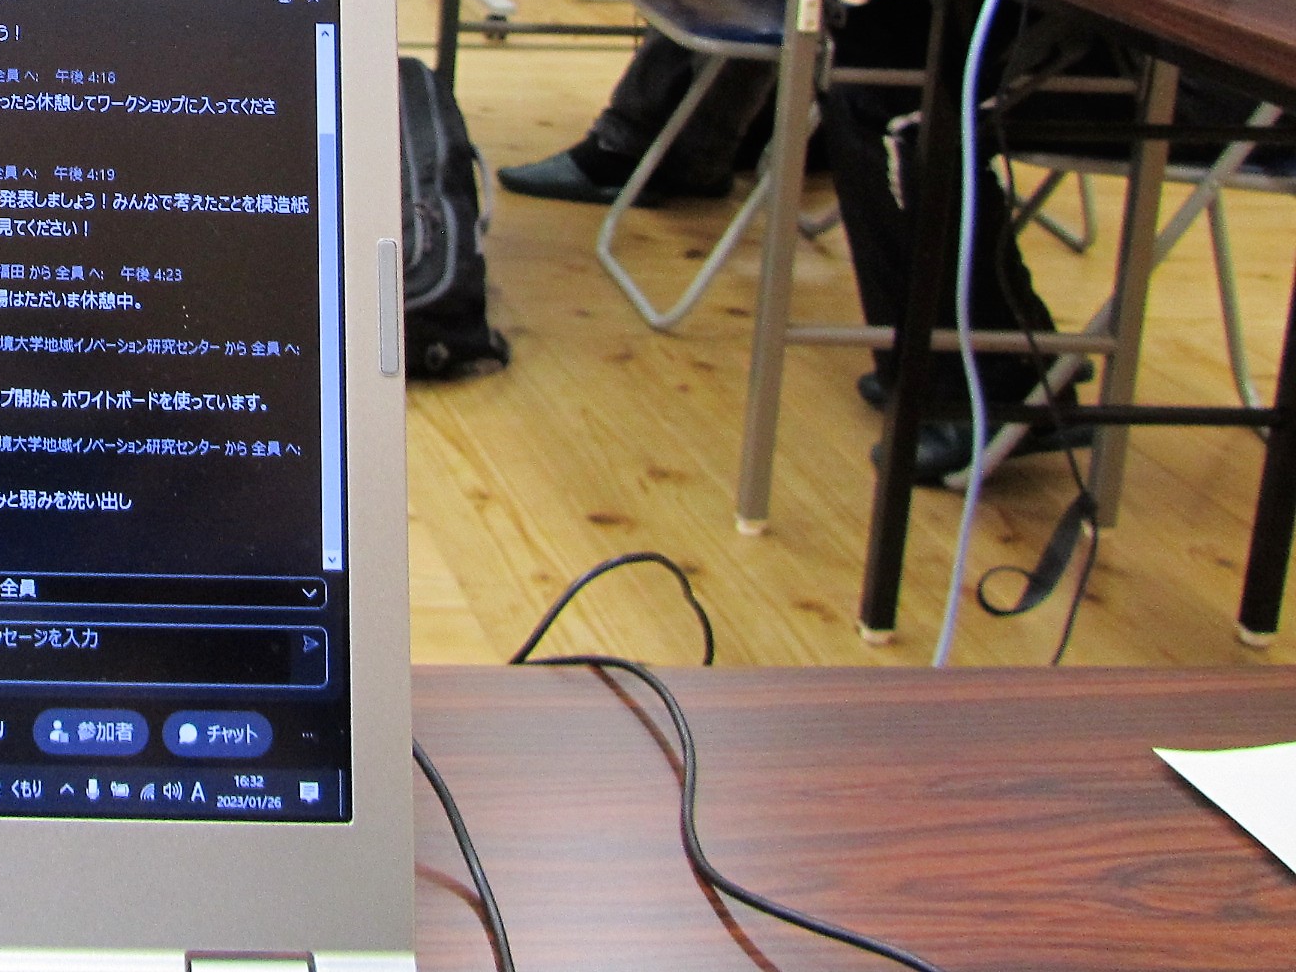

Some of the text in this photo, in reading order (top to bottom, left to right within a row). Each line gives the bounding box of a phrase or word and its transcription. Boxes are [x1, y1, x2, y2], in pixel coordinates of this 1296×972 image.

[55, 68, 84, 85] 午後
[53, 165, 84, 182] 午後
[86, 168, 116, 182] 4:19
[28, 264, 52, 281] から
[55, 265, 85, 281] 全員
[120, 265, 151, 283] 午後
[153, 267, 183, 282] 4:23
[224, 340, 248, 357] から
[251, 340, 281, 357] 全員
[224, 440, 248, 457] から
[251, 440, 282, 457] 全員
[0, 577, 37, 599] 全員
[77, 721, 135, 743] 参加者
[206, 723, 259, 745] チャット
[11, 779, 42, 799] くもり
[233, 775, 265, 789] 16:32
[190, 781, 206, 803] A
[216, 795, 283, 810] 2023/01/26
